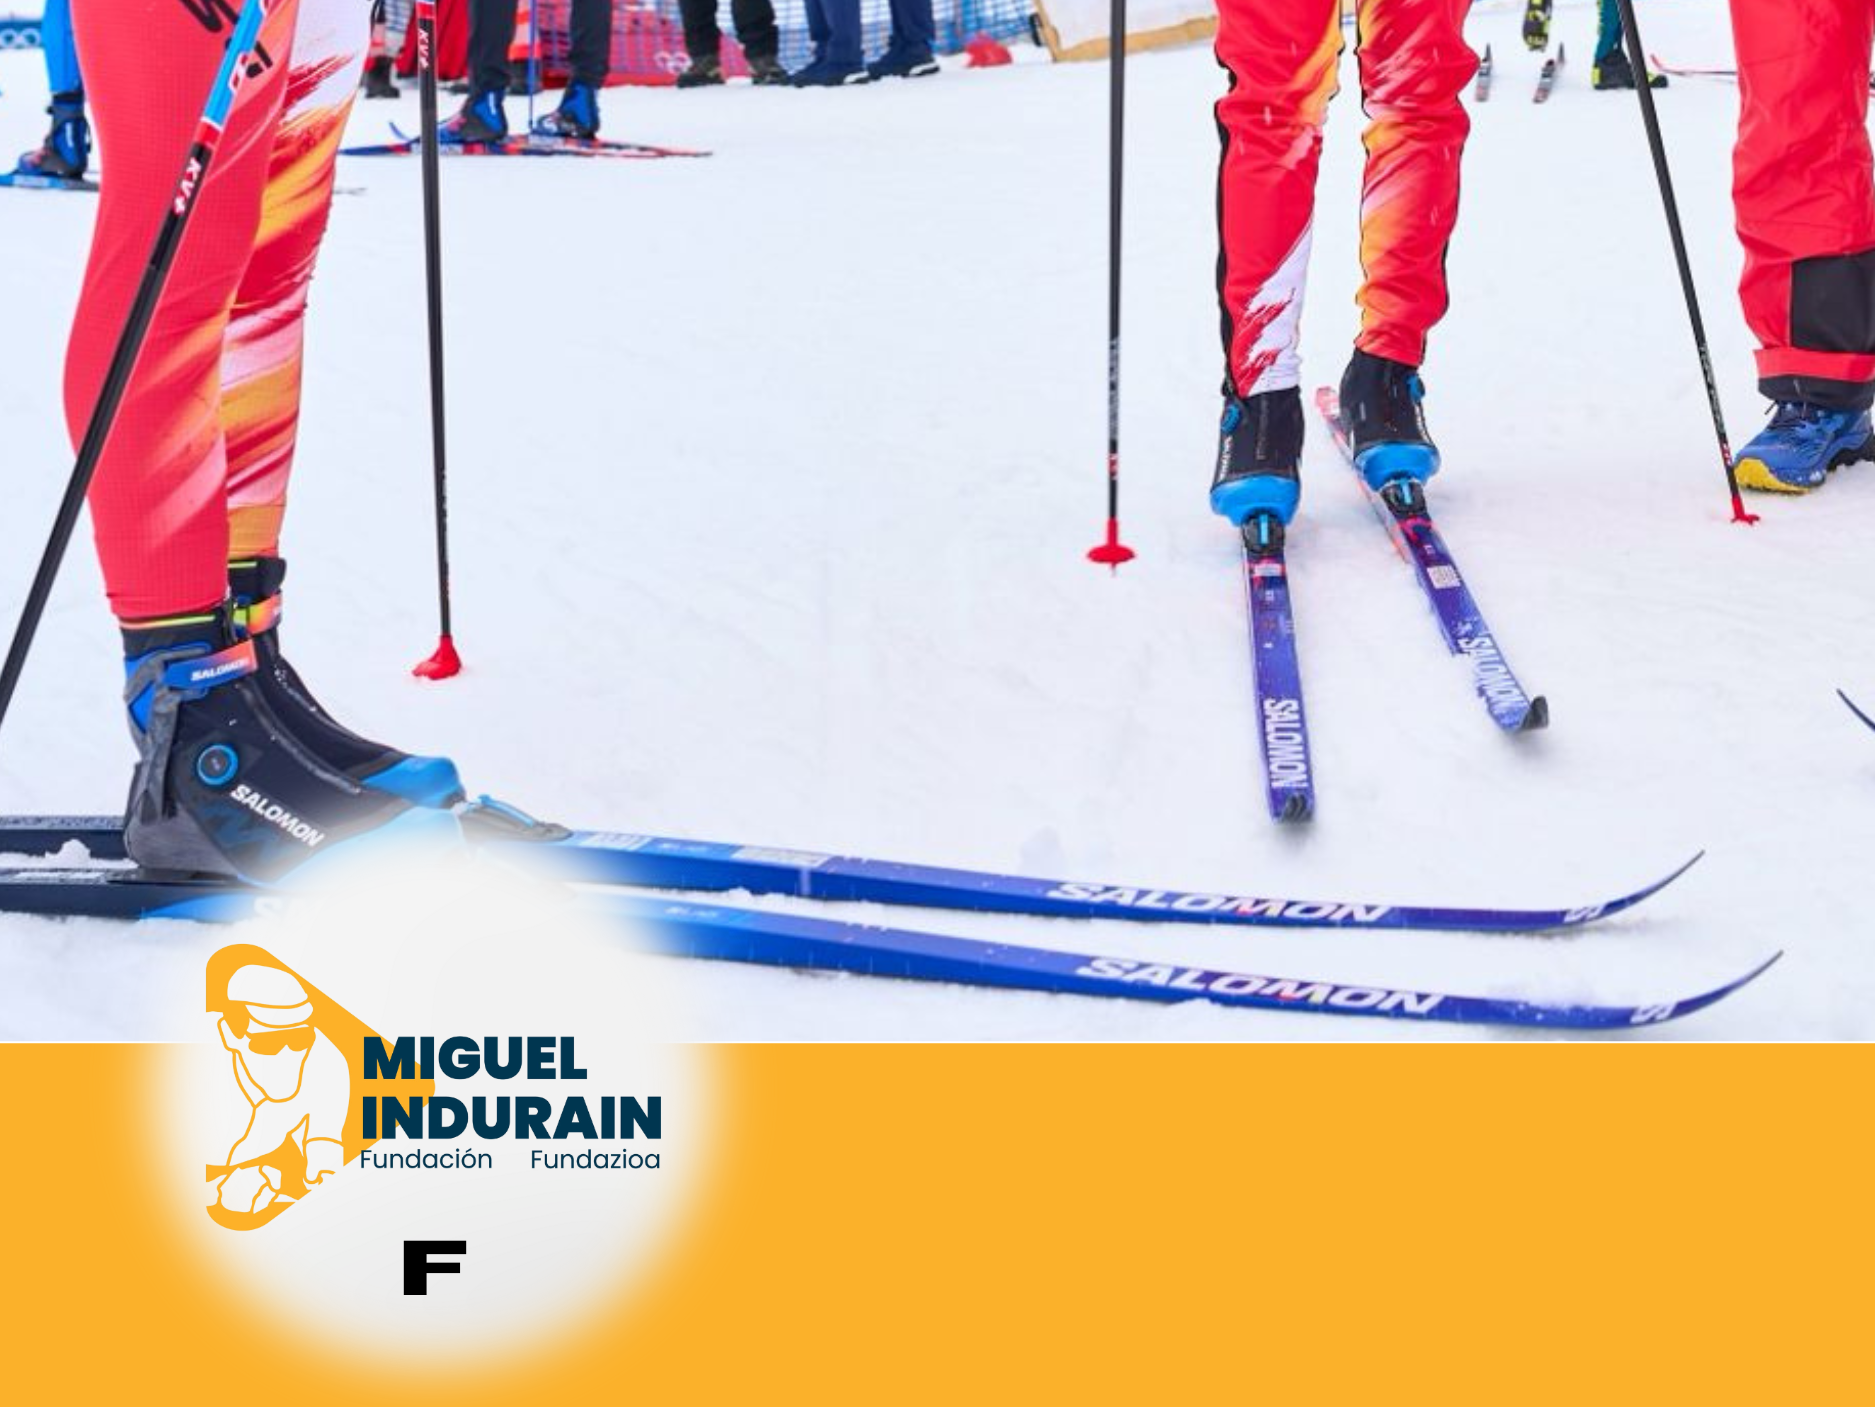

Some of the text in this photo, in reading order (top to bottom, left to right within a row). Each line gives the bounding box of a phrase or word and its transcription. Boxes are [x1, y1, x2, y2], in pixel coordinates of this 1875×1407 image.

[1263, 697, 1310, 789] SALOMON
[230, 784, 325, 846] SALOMON
[1046, 882, 1393, 923] SALOMON
[1075, 958, 1443, 1015] SALOMON
